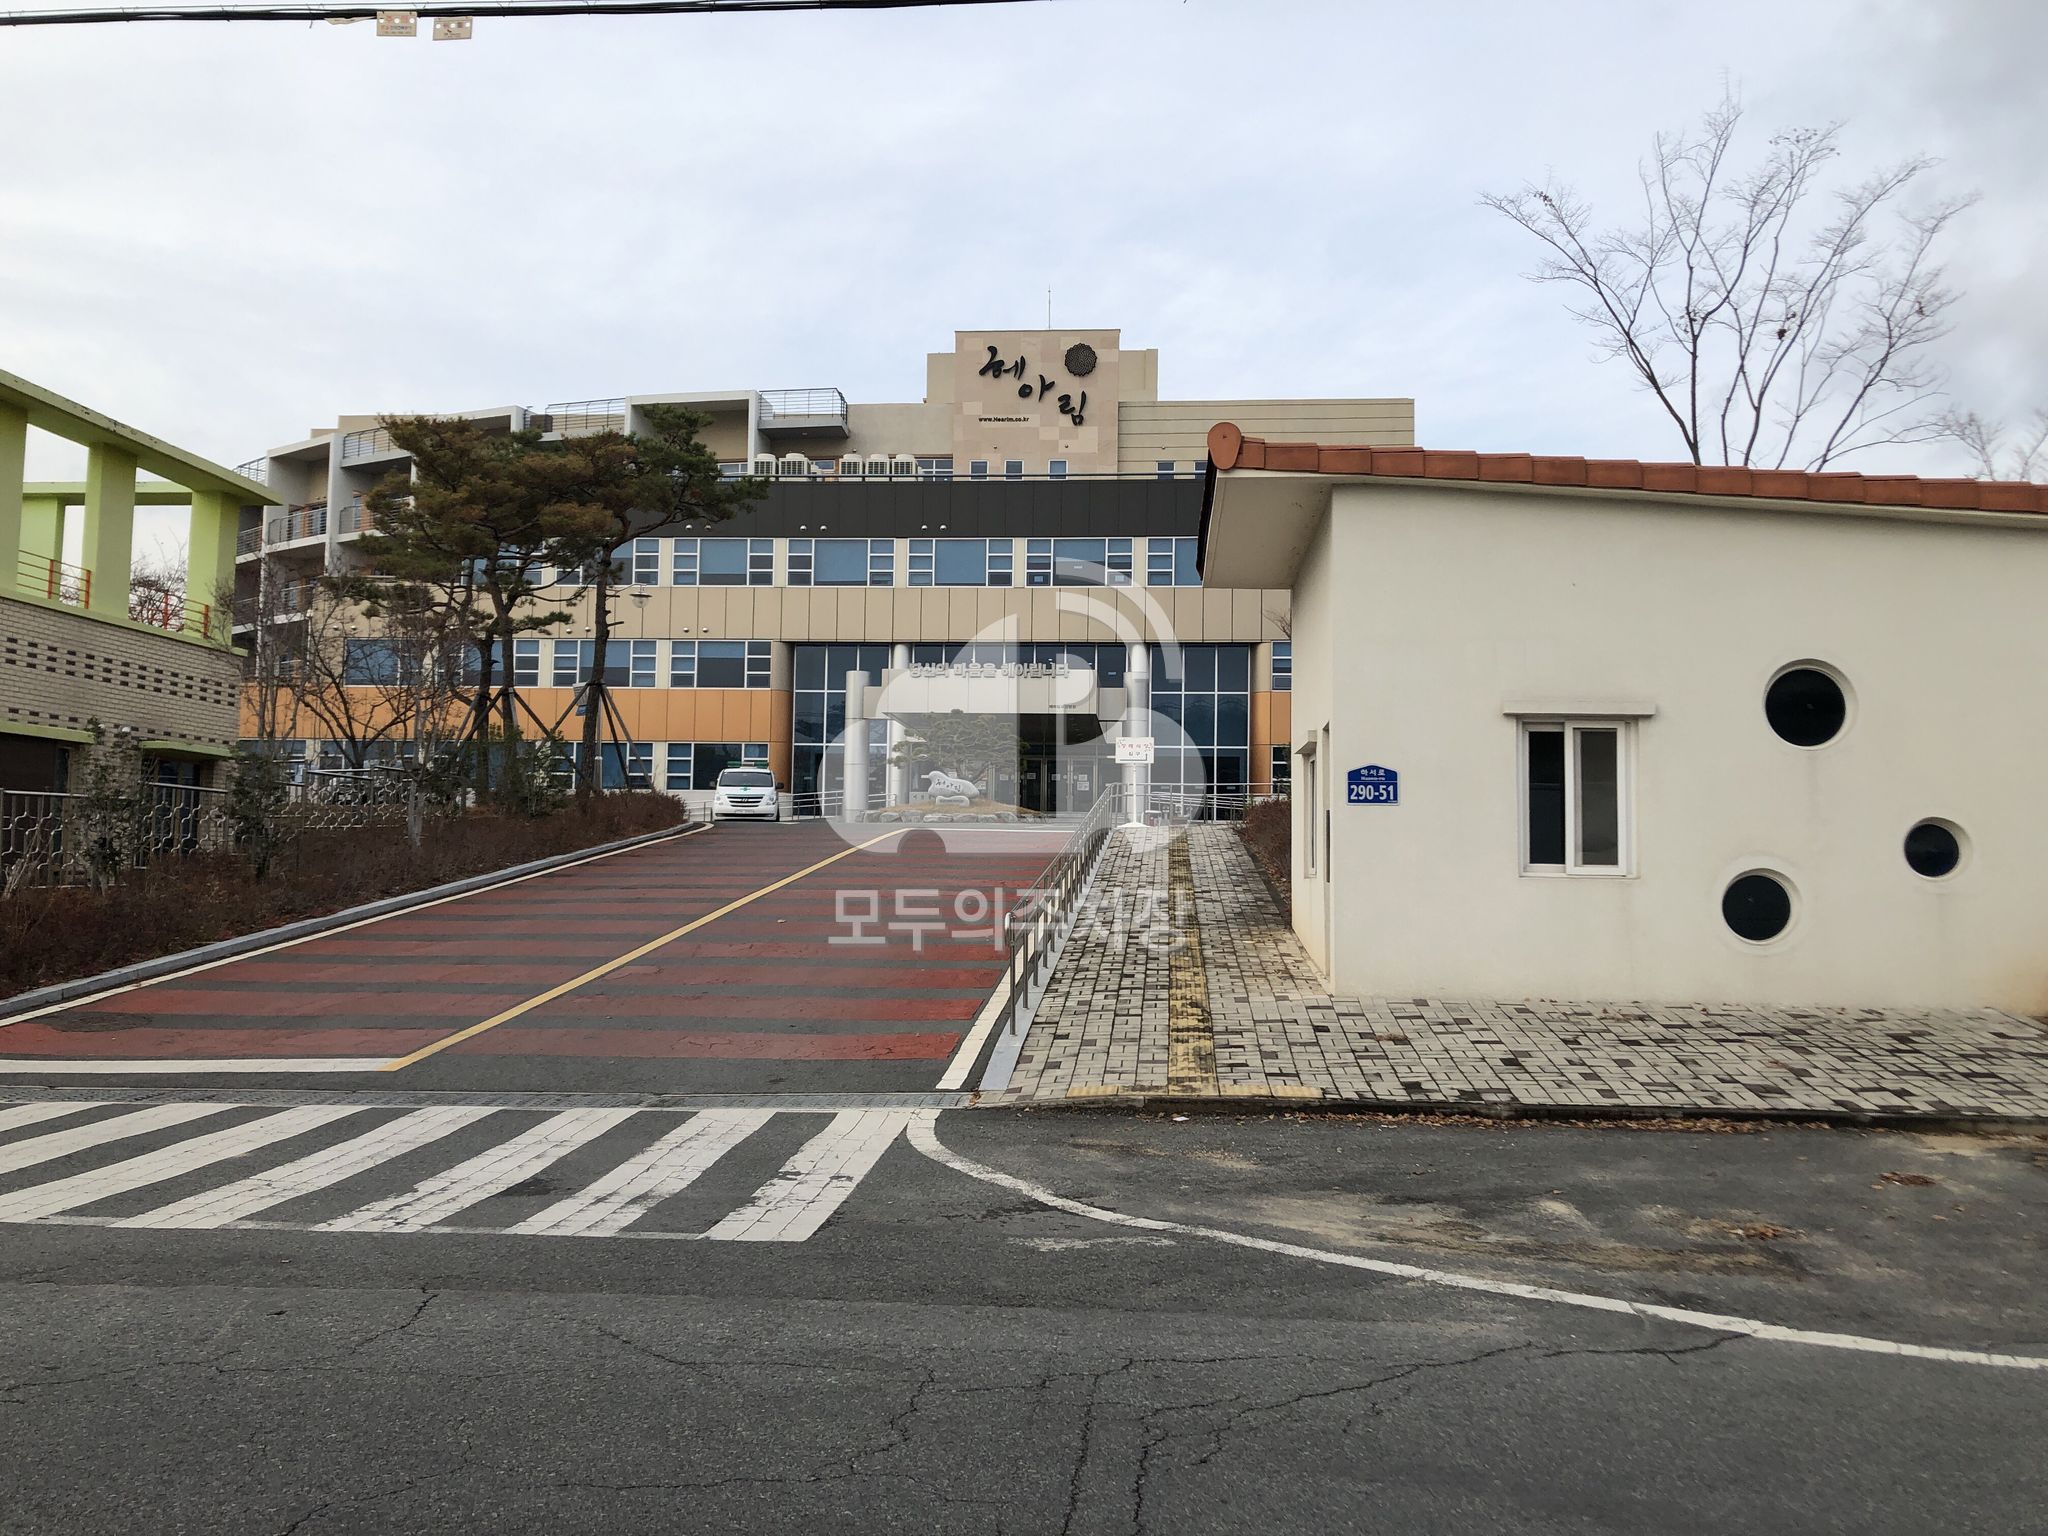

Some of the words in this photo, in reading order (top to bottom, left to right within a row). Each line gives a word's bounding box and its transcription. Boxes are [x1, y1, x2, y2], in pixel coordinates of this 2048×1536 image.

[979, 345, 1086, 426] 헤아림
[909, 662, 950, 678] 당신의
[953, 662, 997, 678] 마음을
[1001, 662, 1070, 678] 헤아립니다
[1350, 785, 1394, 800] 290-51
